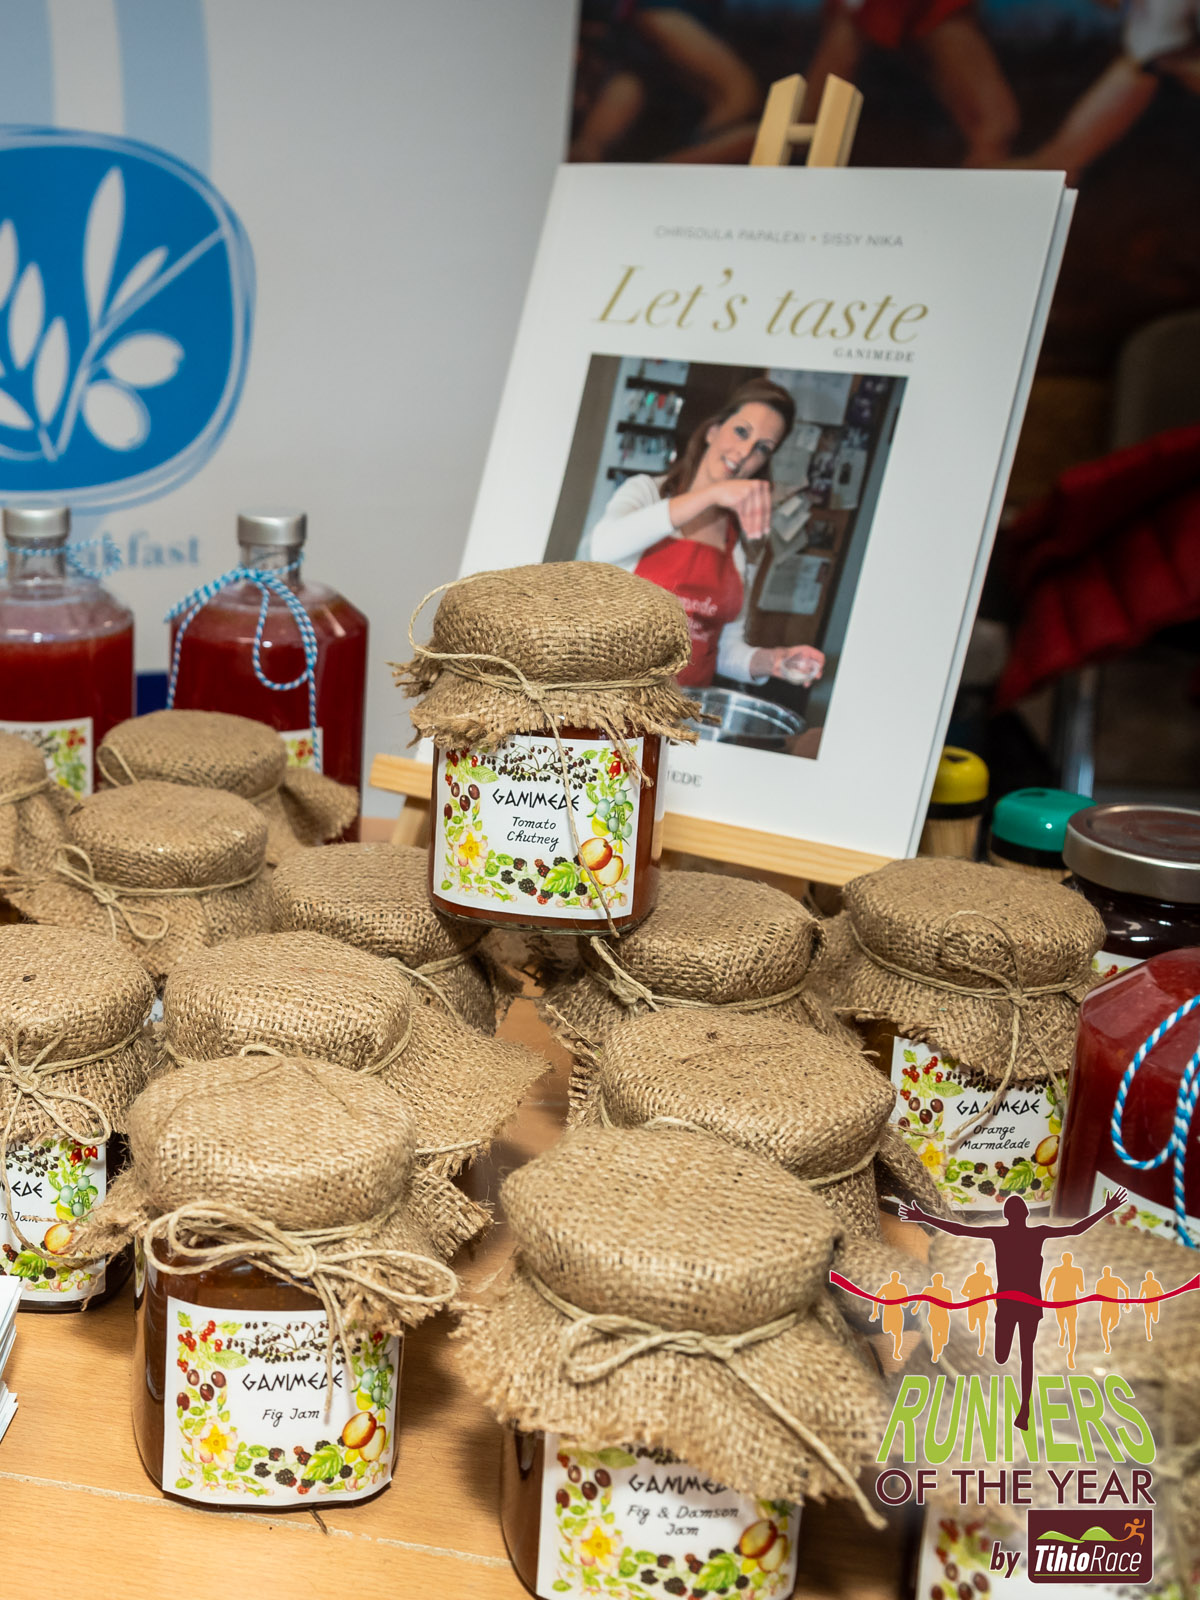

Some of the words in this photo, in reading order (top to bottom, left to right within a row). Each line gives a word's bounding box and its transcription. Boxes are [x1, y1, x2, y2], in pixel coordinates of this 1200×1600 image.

[655, 226, 733, 241] CHRISOULA
[738, 229, 805, 244] PAPALEXI
[822, 233, 861, 246] SISSY
[866, 235, 904, 247] NIKA
[591, 264, 749, 334] Let's
[765, 289, 930, 344] taste
[833, 347, 915, 363] GANIMEDE
[492, 788, 579, 811] GANIMEDE
[512, 816, 557, 830] Tomato
[507, 830, 559, 852] Chutney
[973, 1124, 1015, 1140] Orange
[960, 1139, 1031, 1150] Marmalade
[242, 1370, 343, 1392] GANIMEDE
[262, 1409, 283, 1427] Fig
[290, 1408, 319, 1420] Jam
[628, 1472, 741, 1496] GANIMED
[627, 1504, 650, 1525] Fig
[657, 1505, 670, 1519] &
[676, 1505, 739, 1519] Damson
[666, 1524, 699, 1537] Jam
